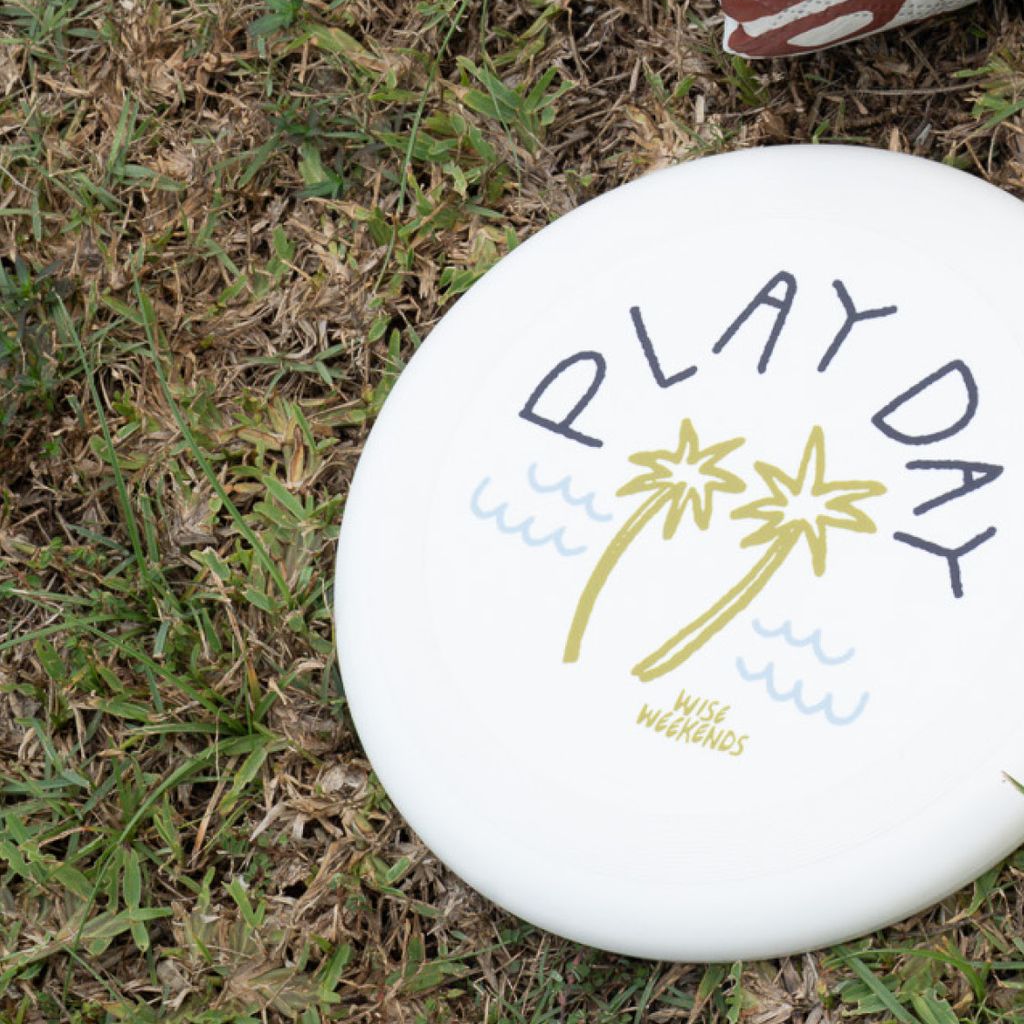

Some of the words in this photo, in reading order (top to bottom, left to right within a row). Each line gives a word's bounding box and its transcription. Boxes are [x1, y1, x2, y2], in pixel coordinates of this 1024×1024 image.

[519, 271, 897, 447] PLAY
[872, 360, 1003, 598] DAY
[635, 703, 750, 757] WEEKENDS
[674, 688, 732, 725] WISE
